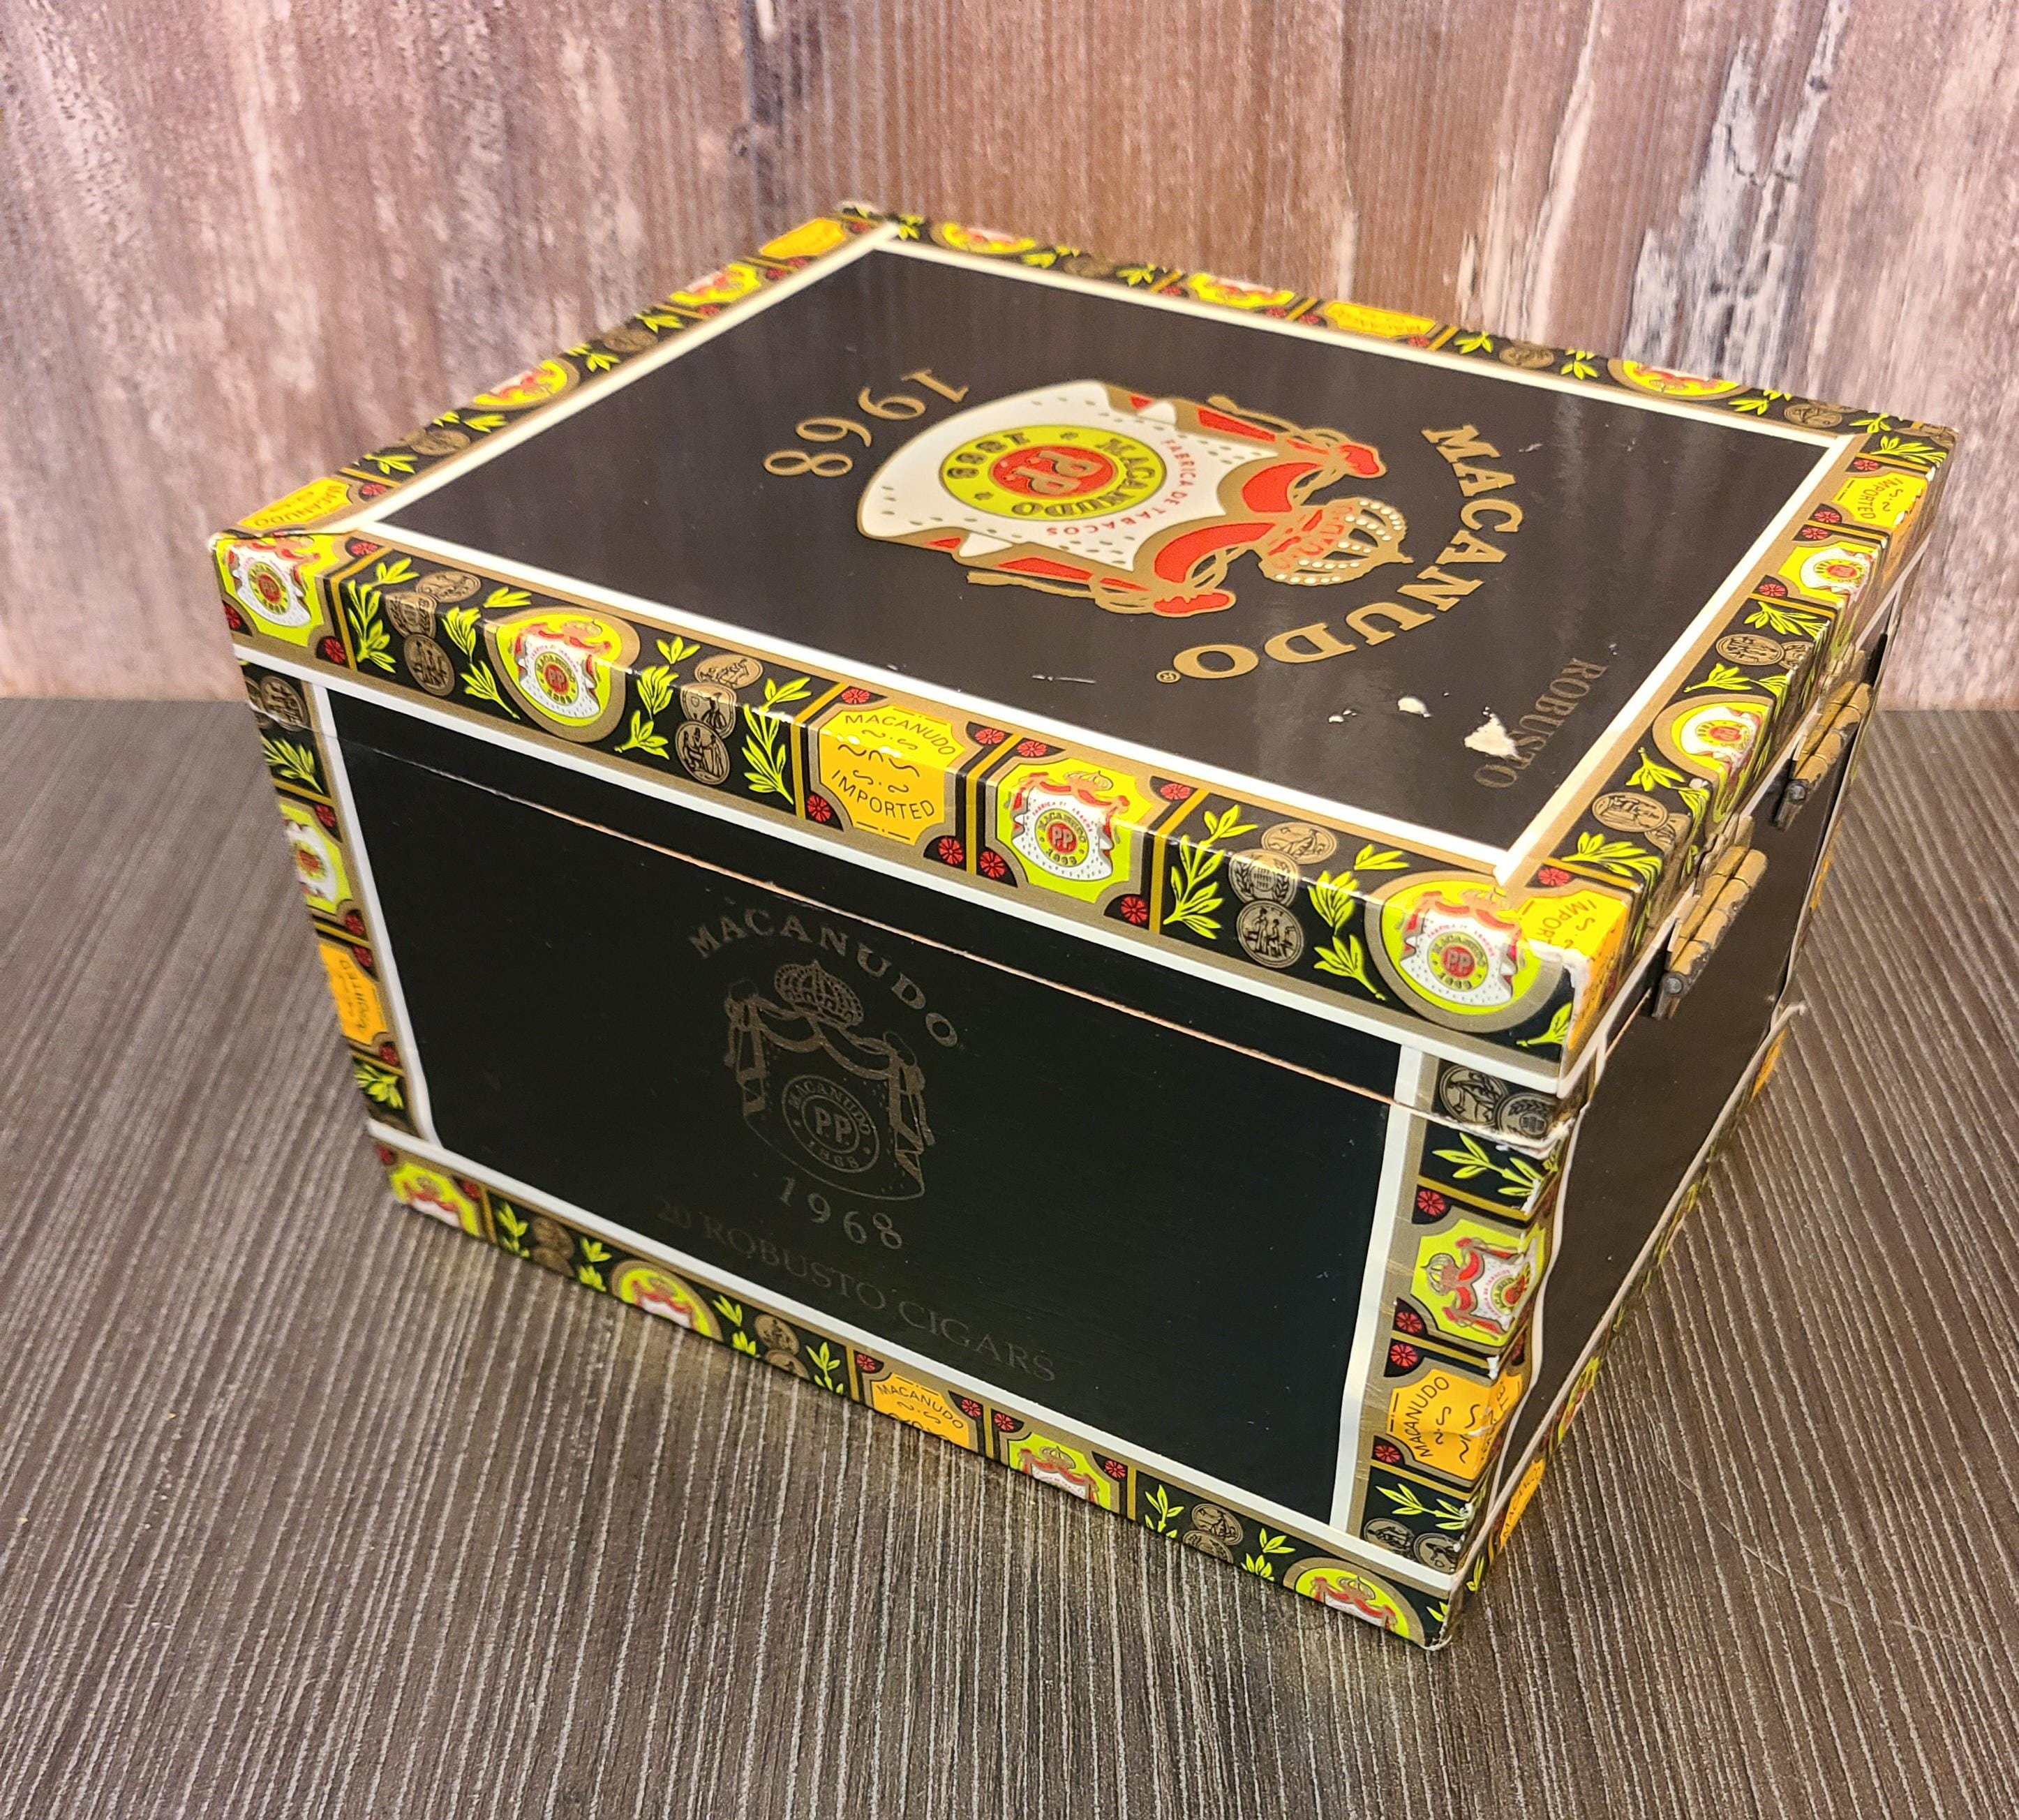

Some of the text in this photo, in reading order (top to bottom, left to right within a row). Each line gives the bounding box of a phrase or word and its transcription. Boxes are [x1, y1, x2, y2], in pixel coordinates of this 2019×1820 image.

[765, 369, 969, 477] 1968
[1046, 438, 1197, 536] FABRICA DE TABACOS
[1857, 477, 1904, 519] IMPORTED
[1173, 424, 1523, 679] MACANUDO
[845, 714, 955, 755] MACANUDO
[1474, 657, 1608, 788] ROBUSTO
[831, 770, 934, 819] IMPORTED
[688, 908, 958, 1047] MACANUDO
[780, 1177, 903, 1250] 1968
[701, 1212, 886, 1310] ROBUSTO
[898, 1299, 1056, 1382] CIGARS
[876, 1383, 964, 1430] MACANUDO
[1403, 1375, 1450, 1459] MACANUDO
